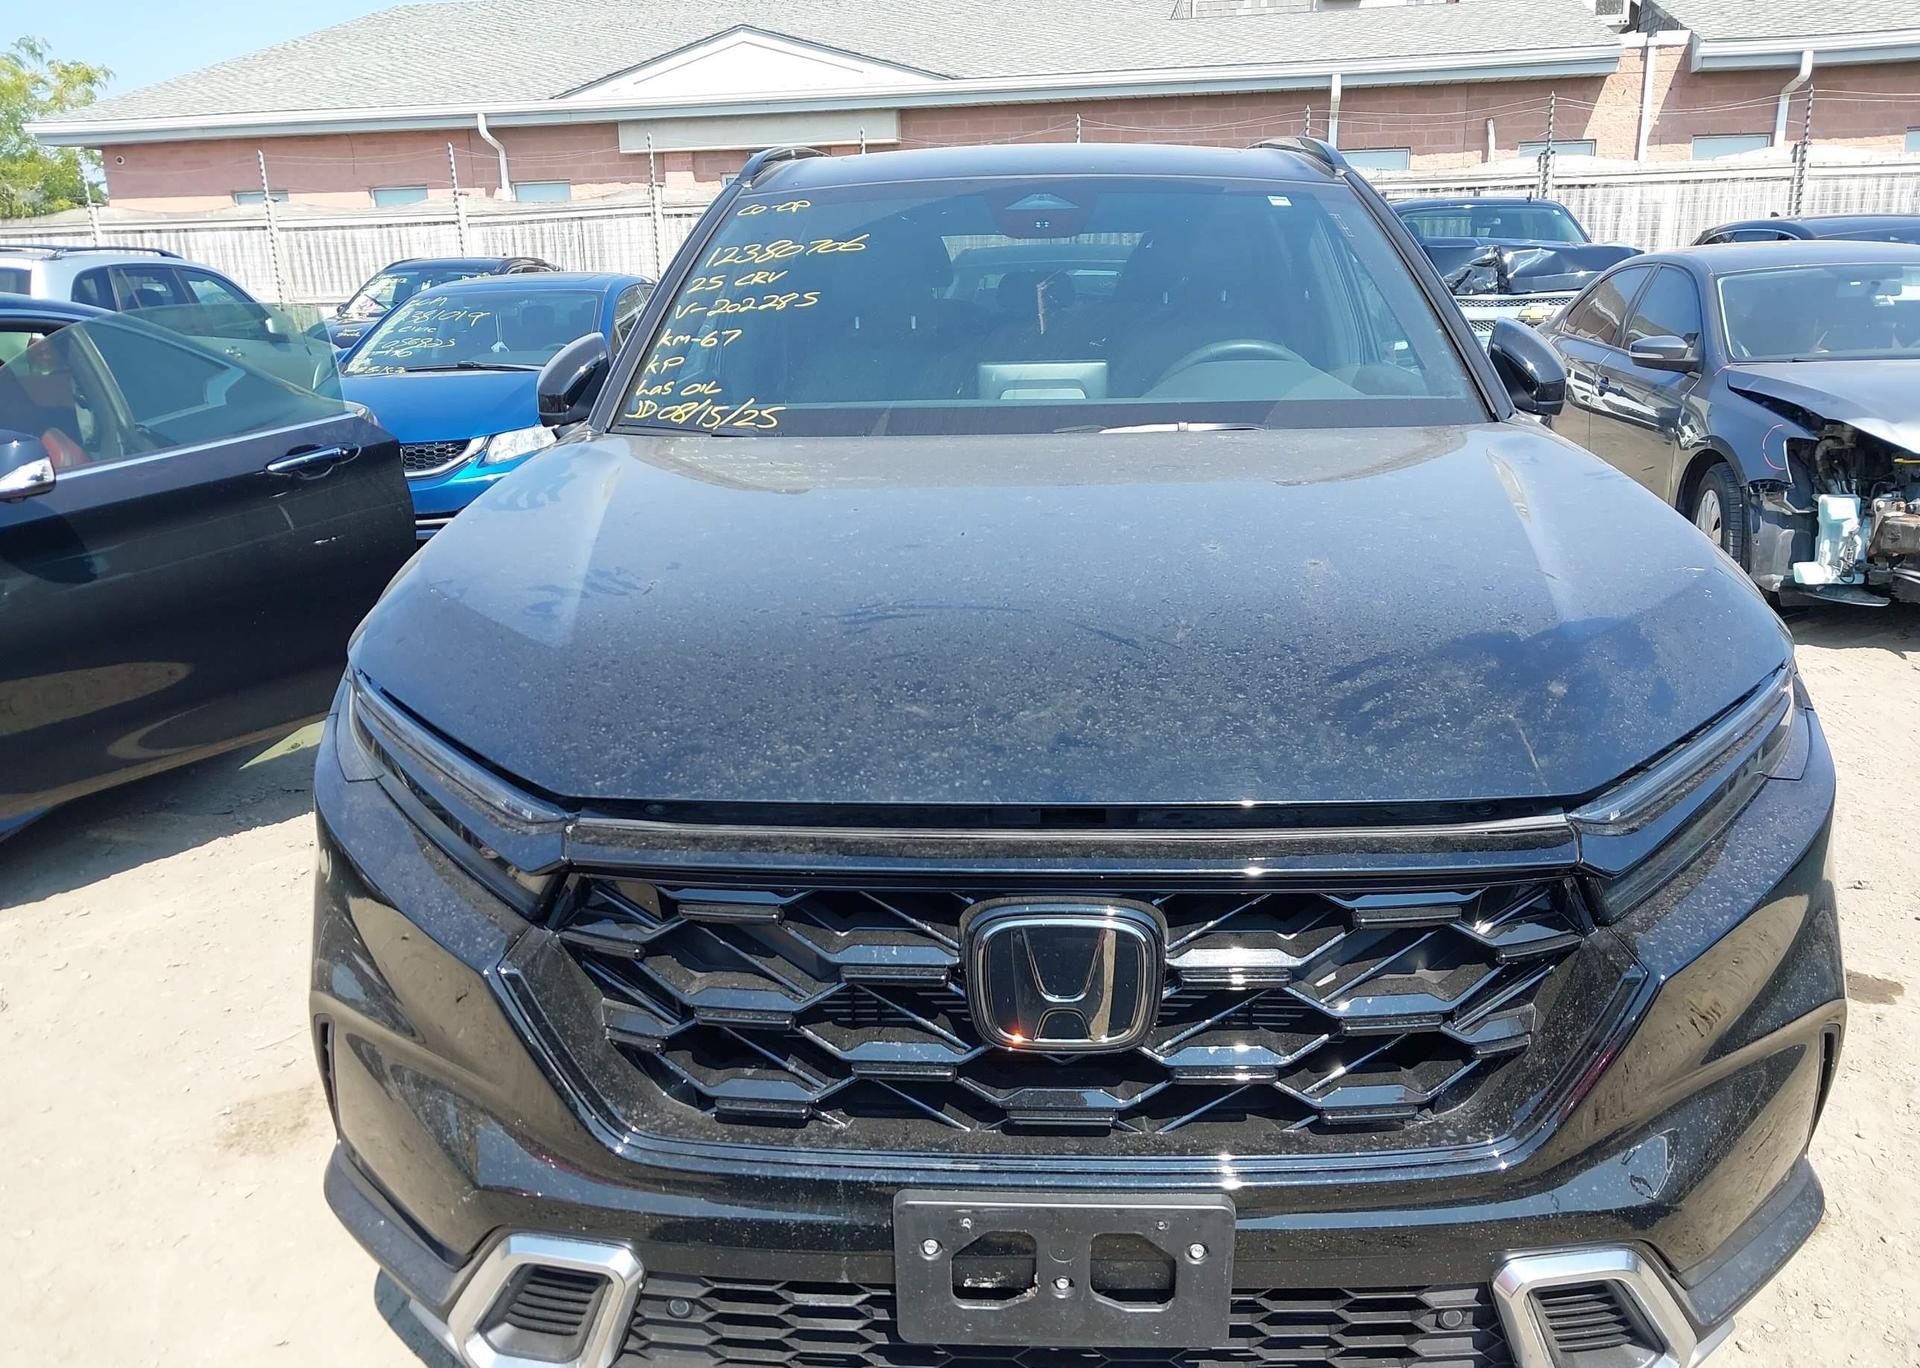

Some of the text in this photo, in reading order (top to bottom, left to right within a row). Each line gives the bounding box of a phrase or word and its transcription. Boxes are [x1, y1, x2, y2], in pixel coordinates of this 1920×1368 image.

[706, 234, 870, 267] 12380706
[687, 270, 790, 293] 25 CRV
